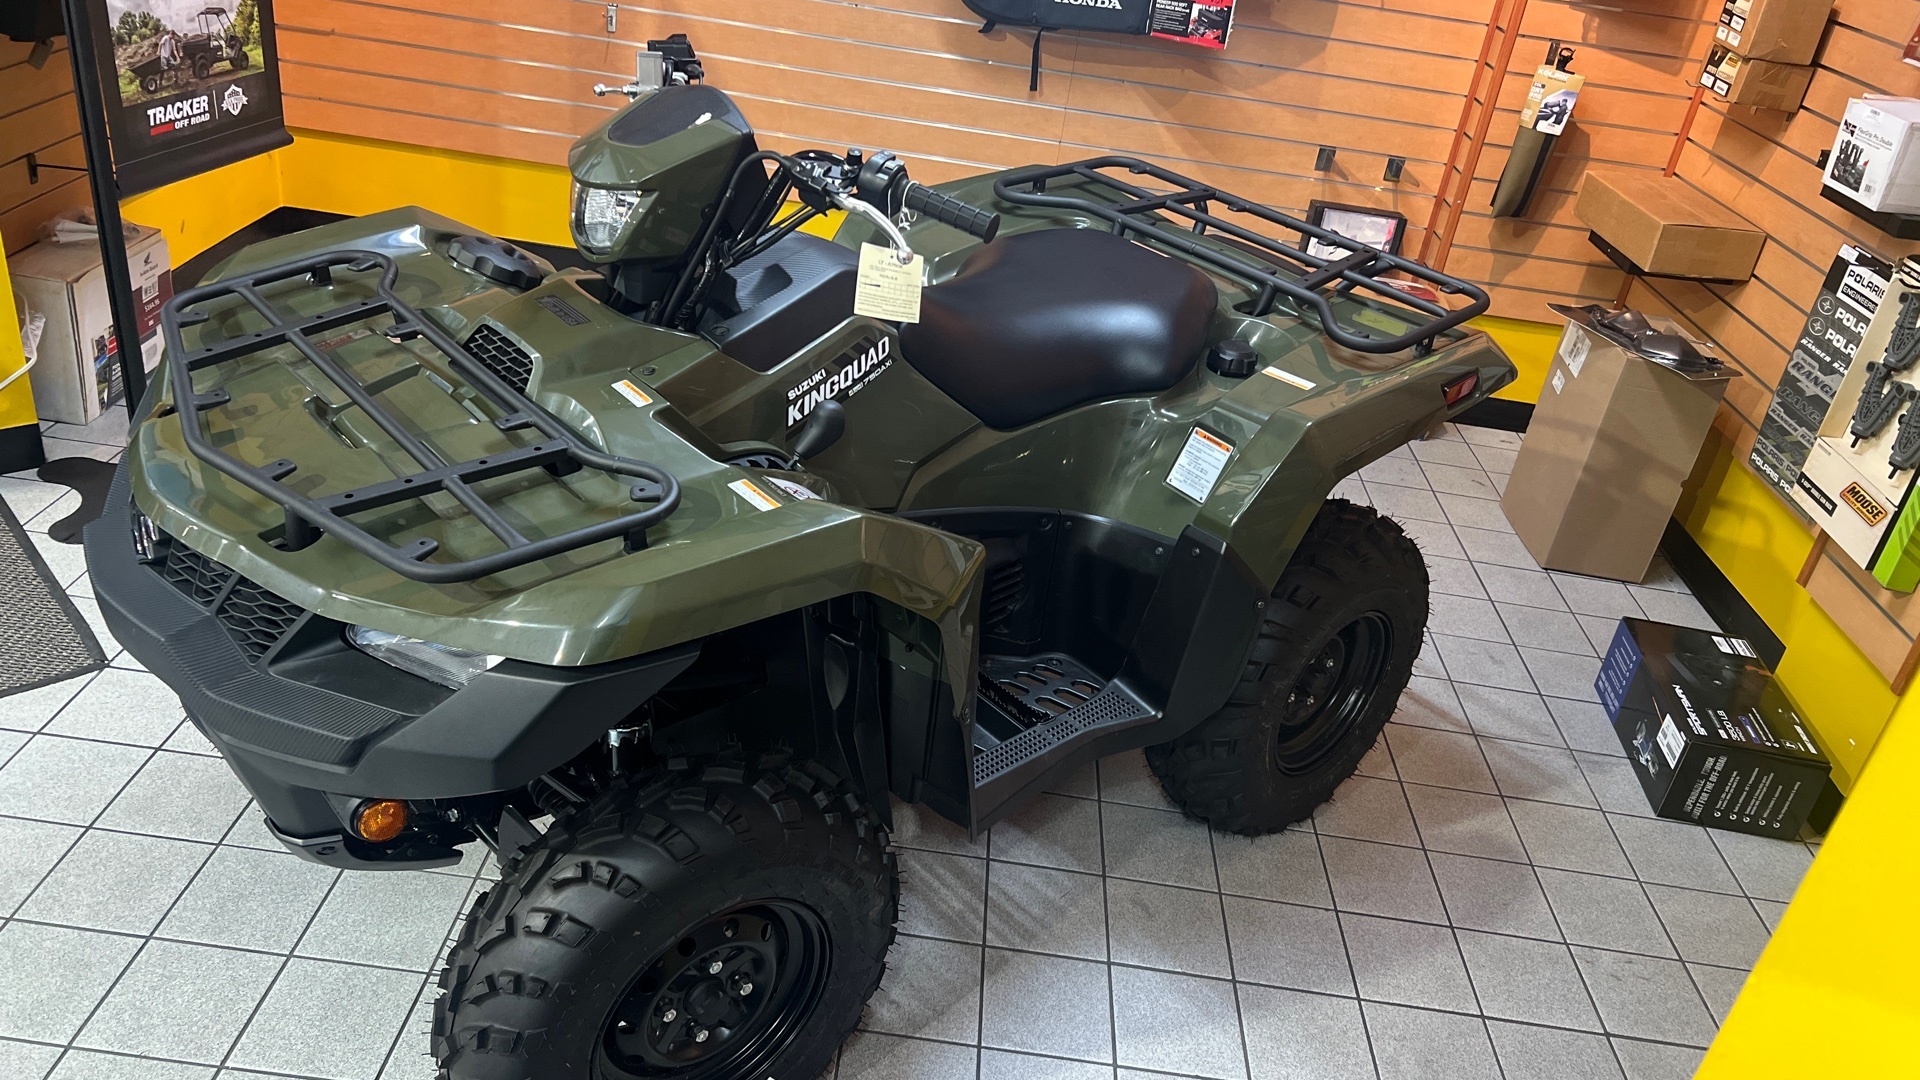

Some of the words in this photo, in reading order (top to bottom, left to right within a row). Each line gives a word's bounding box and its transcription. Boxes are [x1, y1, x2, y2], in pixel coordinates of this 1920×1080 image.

[147, 95, 209, 126] TRACKER
[174, 119, 190, 129] OFF
[190, 113, 210, 125] ROAD
[1801, 338, 1832, 362] RANGER
[787, 336, 890, 427] KINGQUAD
[787, 368, 826, 400] SUZUKI
[1751, 452, 1779, 482] POLARIS
[1757, 437, 1785, 467] POLARIS
[1847, 485, 1883, 520] MOOSE
[1672, 684, 1708, 736] SPORTSMAN
[1717, 710, 1728, 720] LB
[1698, 792, 1710, 804] FOR
[1704, 781, 1715, 792] THE
